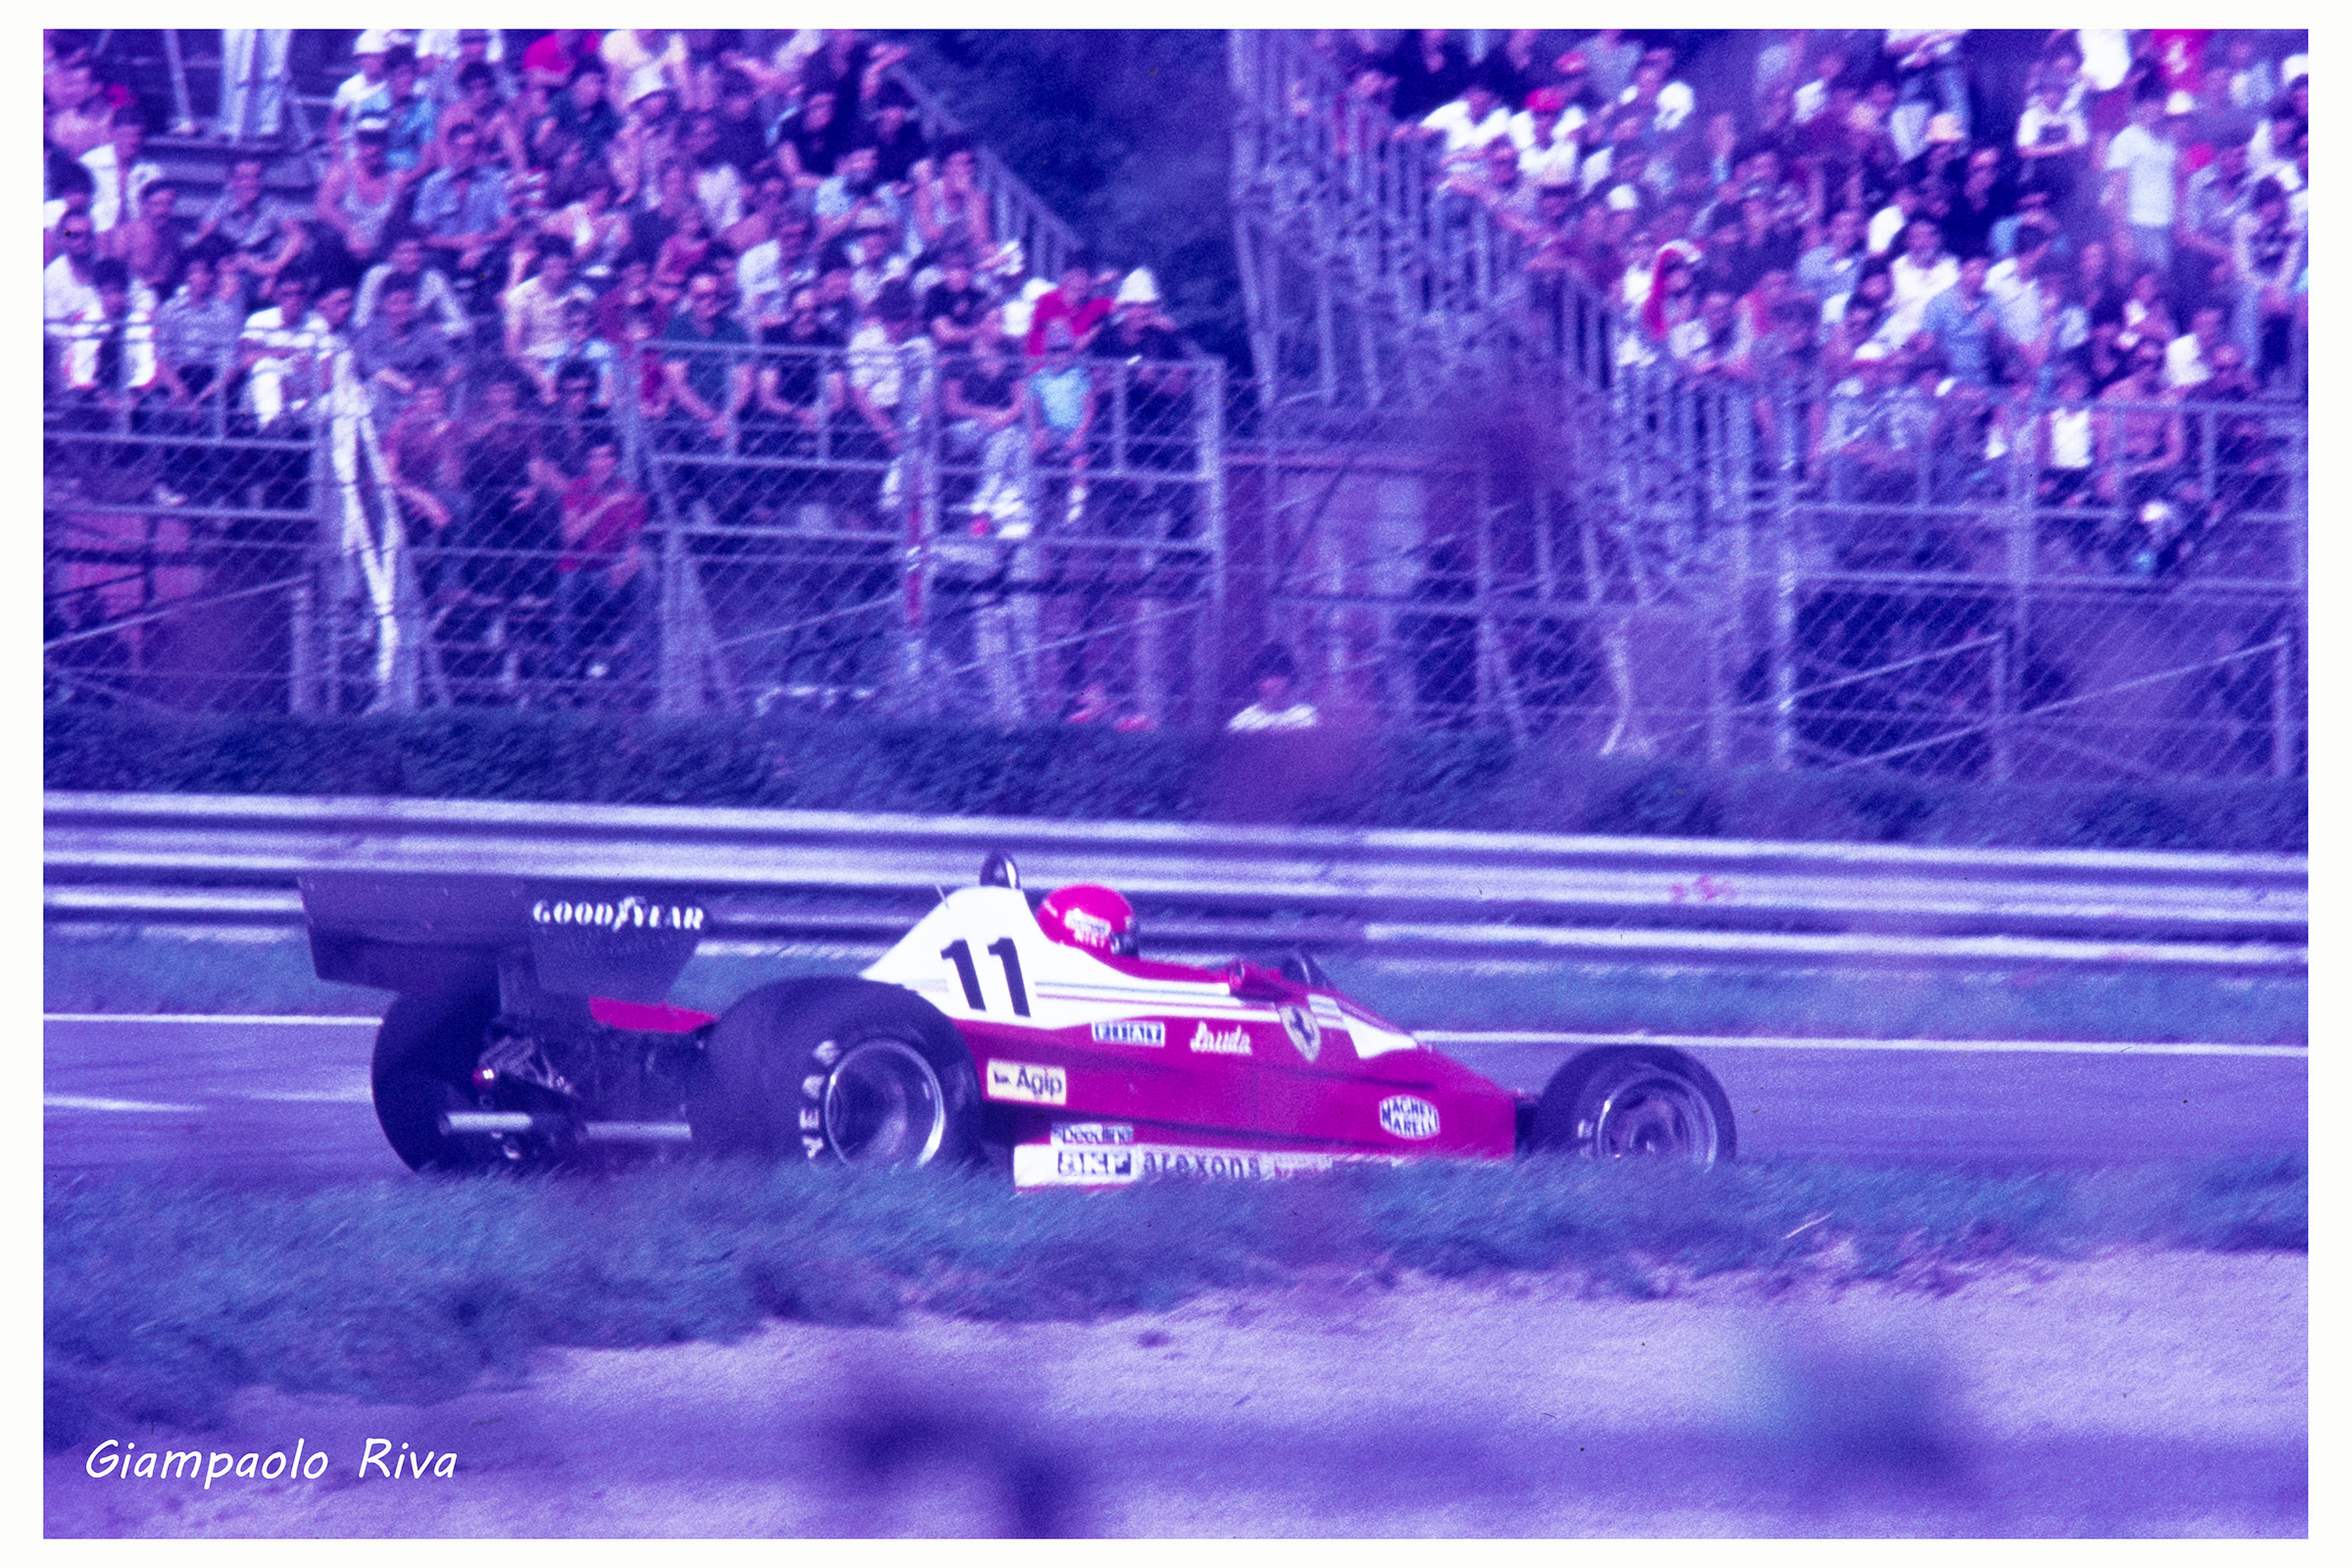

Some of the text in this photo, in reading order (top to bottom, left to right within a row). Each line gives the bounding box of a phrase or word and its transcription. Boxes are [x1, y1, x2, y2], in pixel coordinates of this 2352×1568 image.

[532, 896, 705, 931] GOODYEAR
[940, 936, 1032, 1017] 11
[1091, 1021, 1165, 1048] FIAT
[1190, 1020, 1252, 1055] Lauda
[1016, 1064, 1063, 1098] Agip
